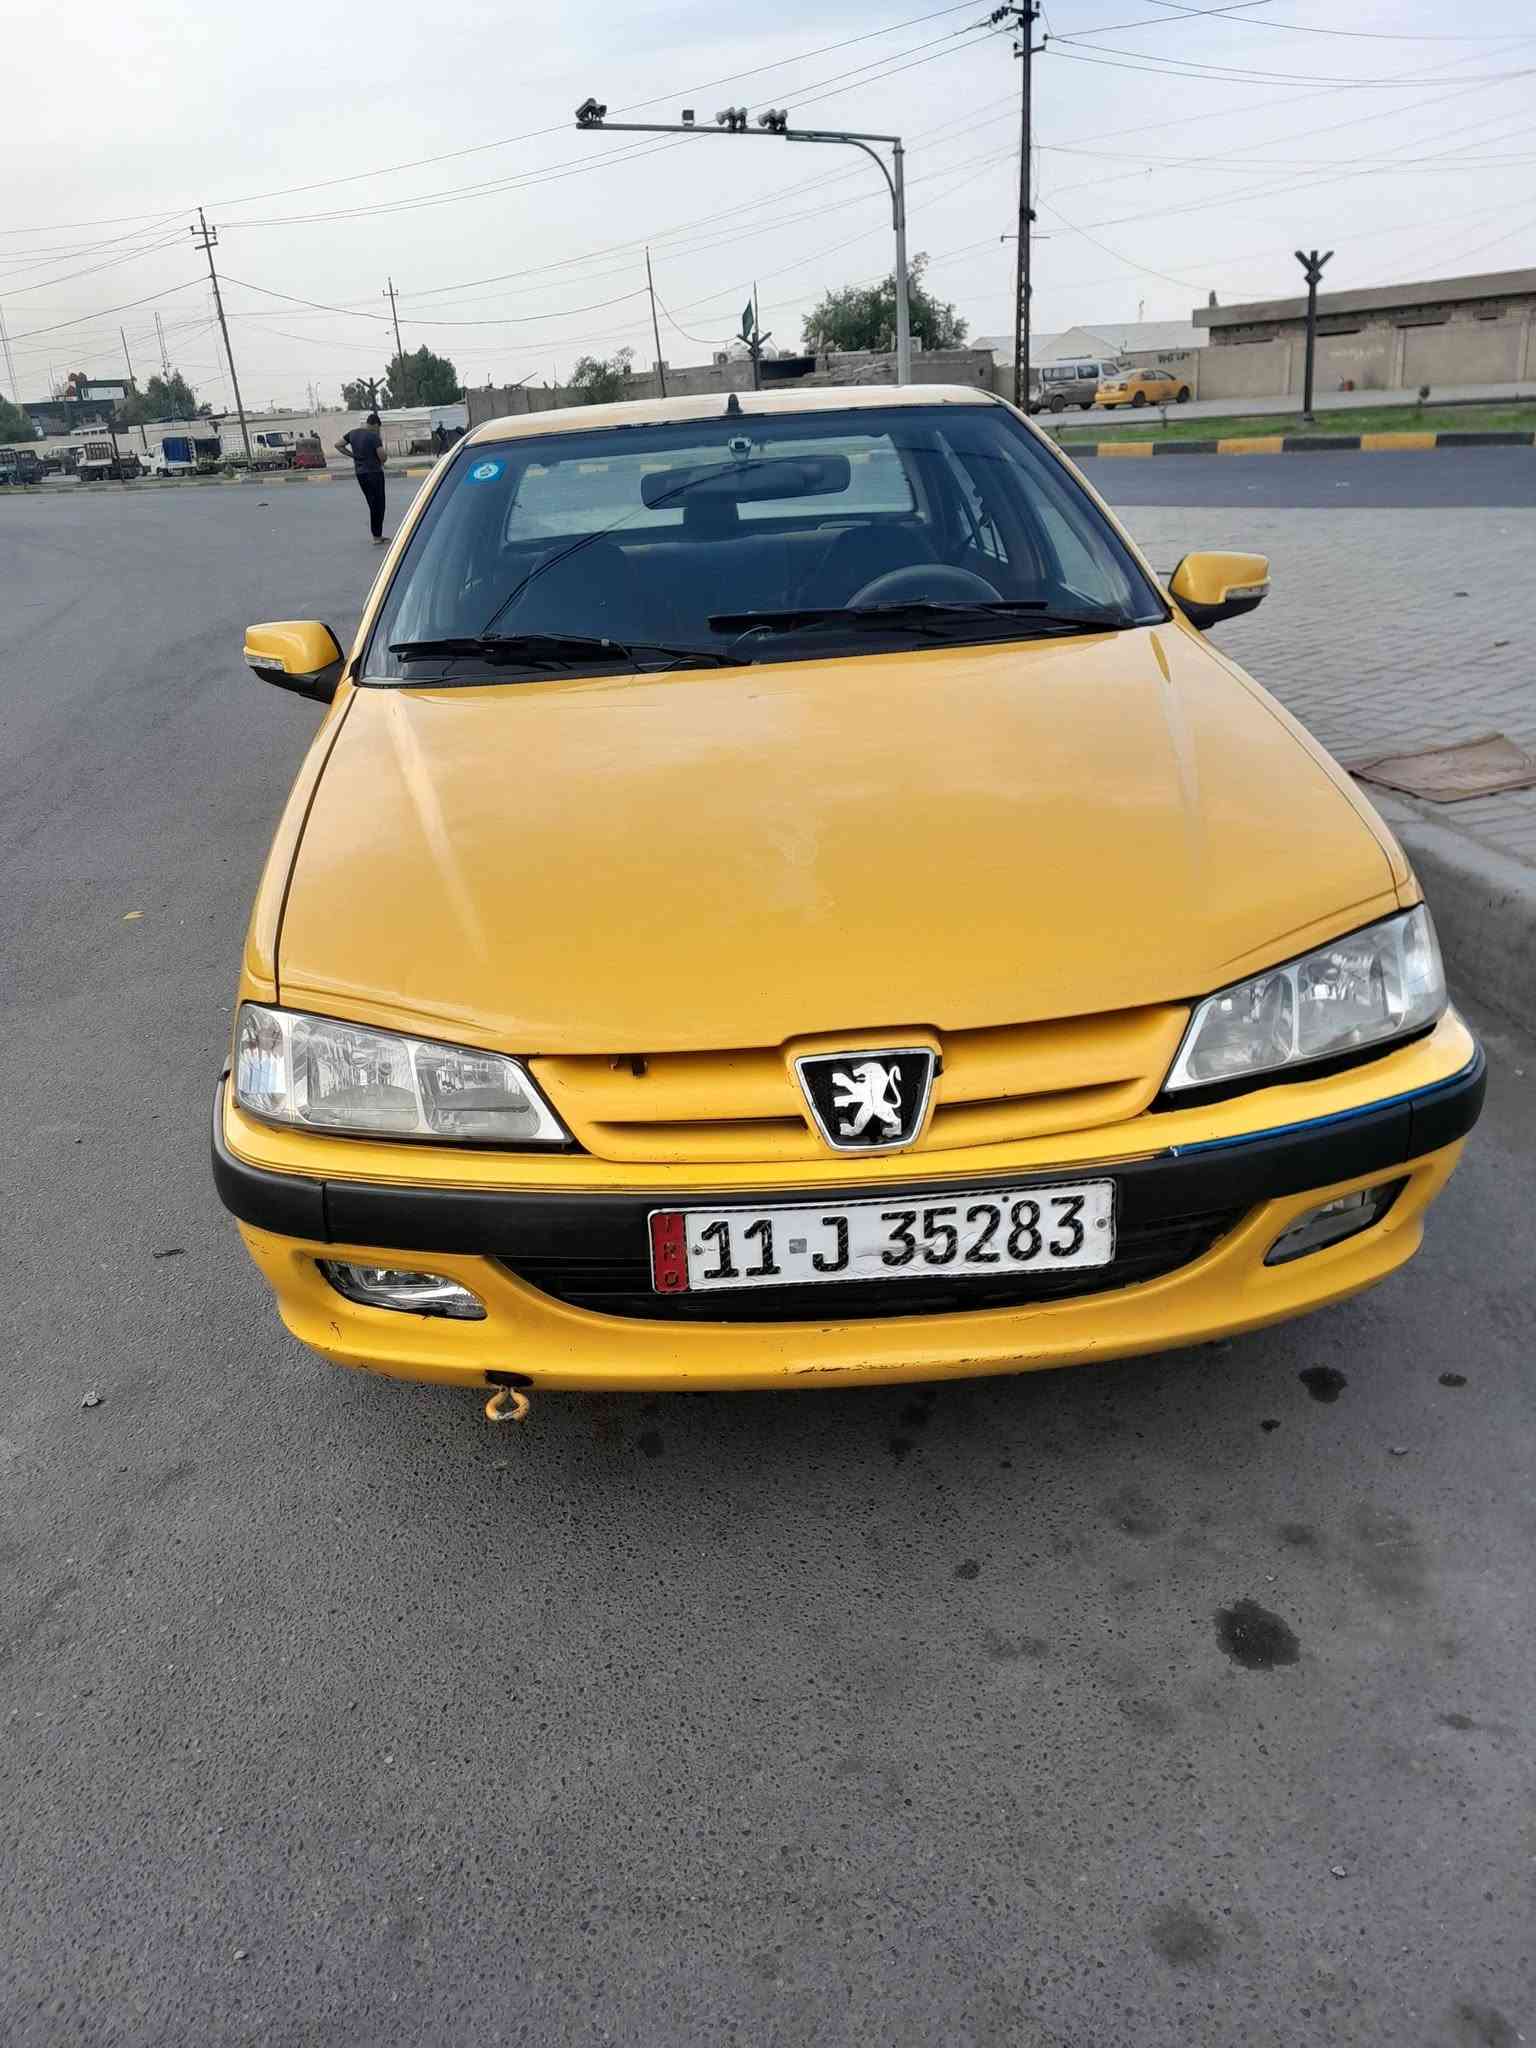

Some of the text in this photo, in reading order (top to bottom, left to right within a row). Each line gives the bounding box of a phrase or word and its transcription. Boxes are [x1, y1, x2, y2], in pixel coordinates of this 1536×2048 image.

[701, 1194, 1085, 1279] 11 J 35283
